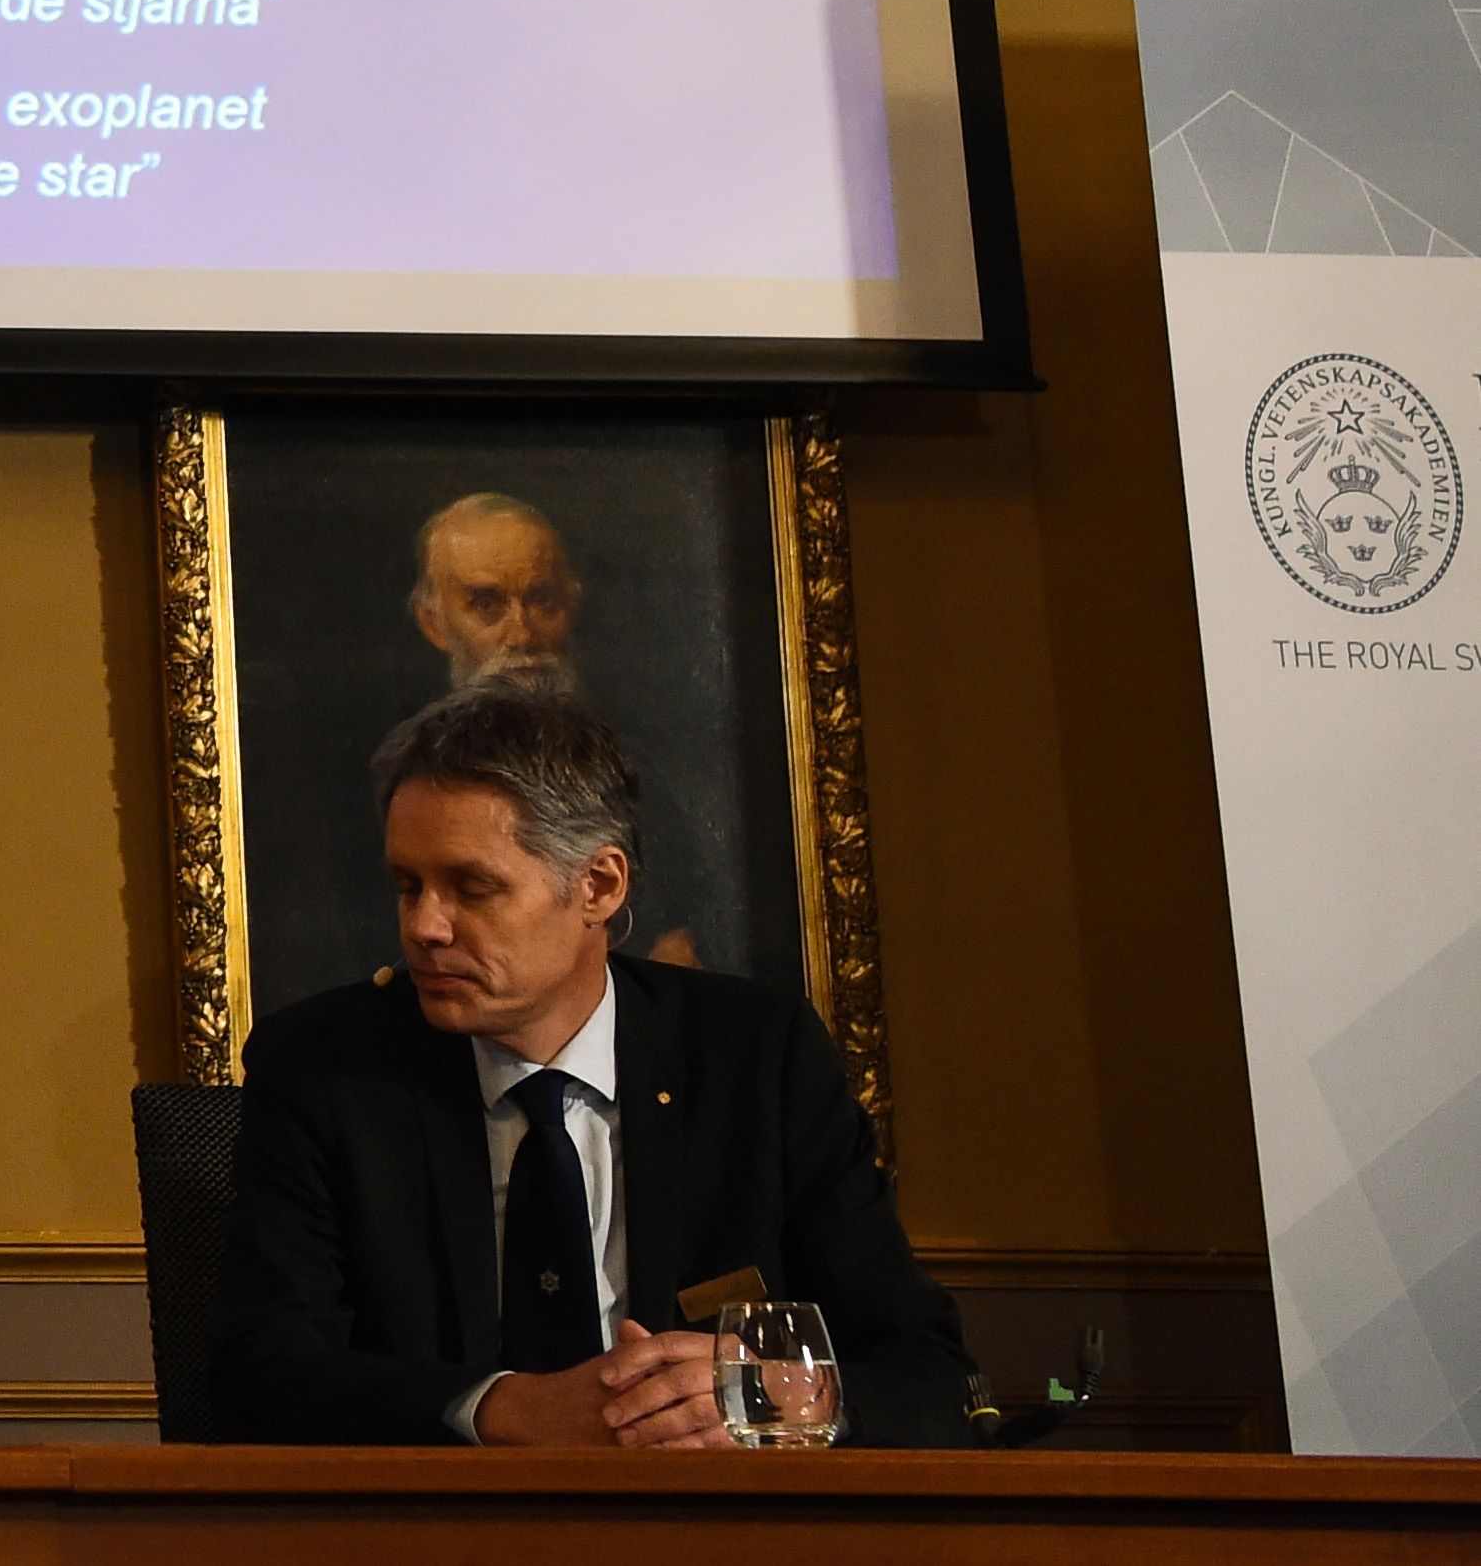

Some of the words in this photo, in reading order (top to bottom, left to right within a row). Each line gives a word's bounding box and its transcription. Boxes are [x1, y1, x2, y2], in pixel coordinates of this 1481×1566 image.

[6, 83, 269, 139] exoplanet
[1258, 444, 1293, 539] KUNGL.
[1261, 366, 1450, 543] VETENSKAPSAKADEMIEN
[1272, 639, 1337, 669] THE
[1347, 641, 1447, 671] ROYAL
